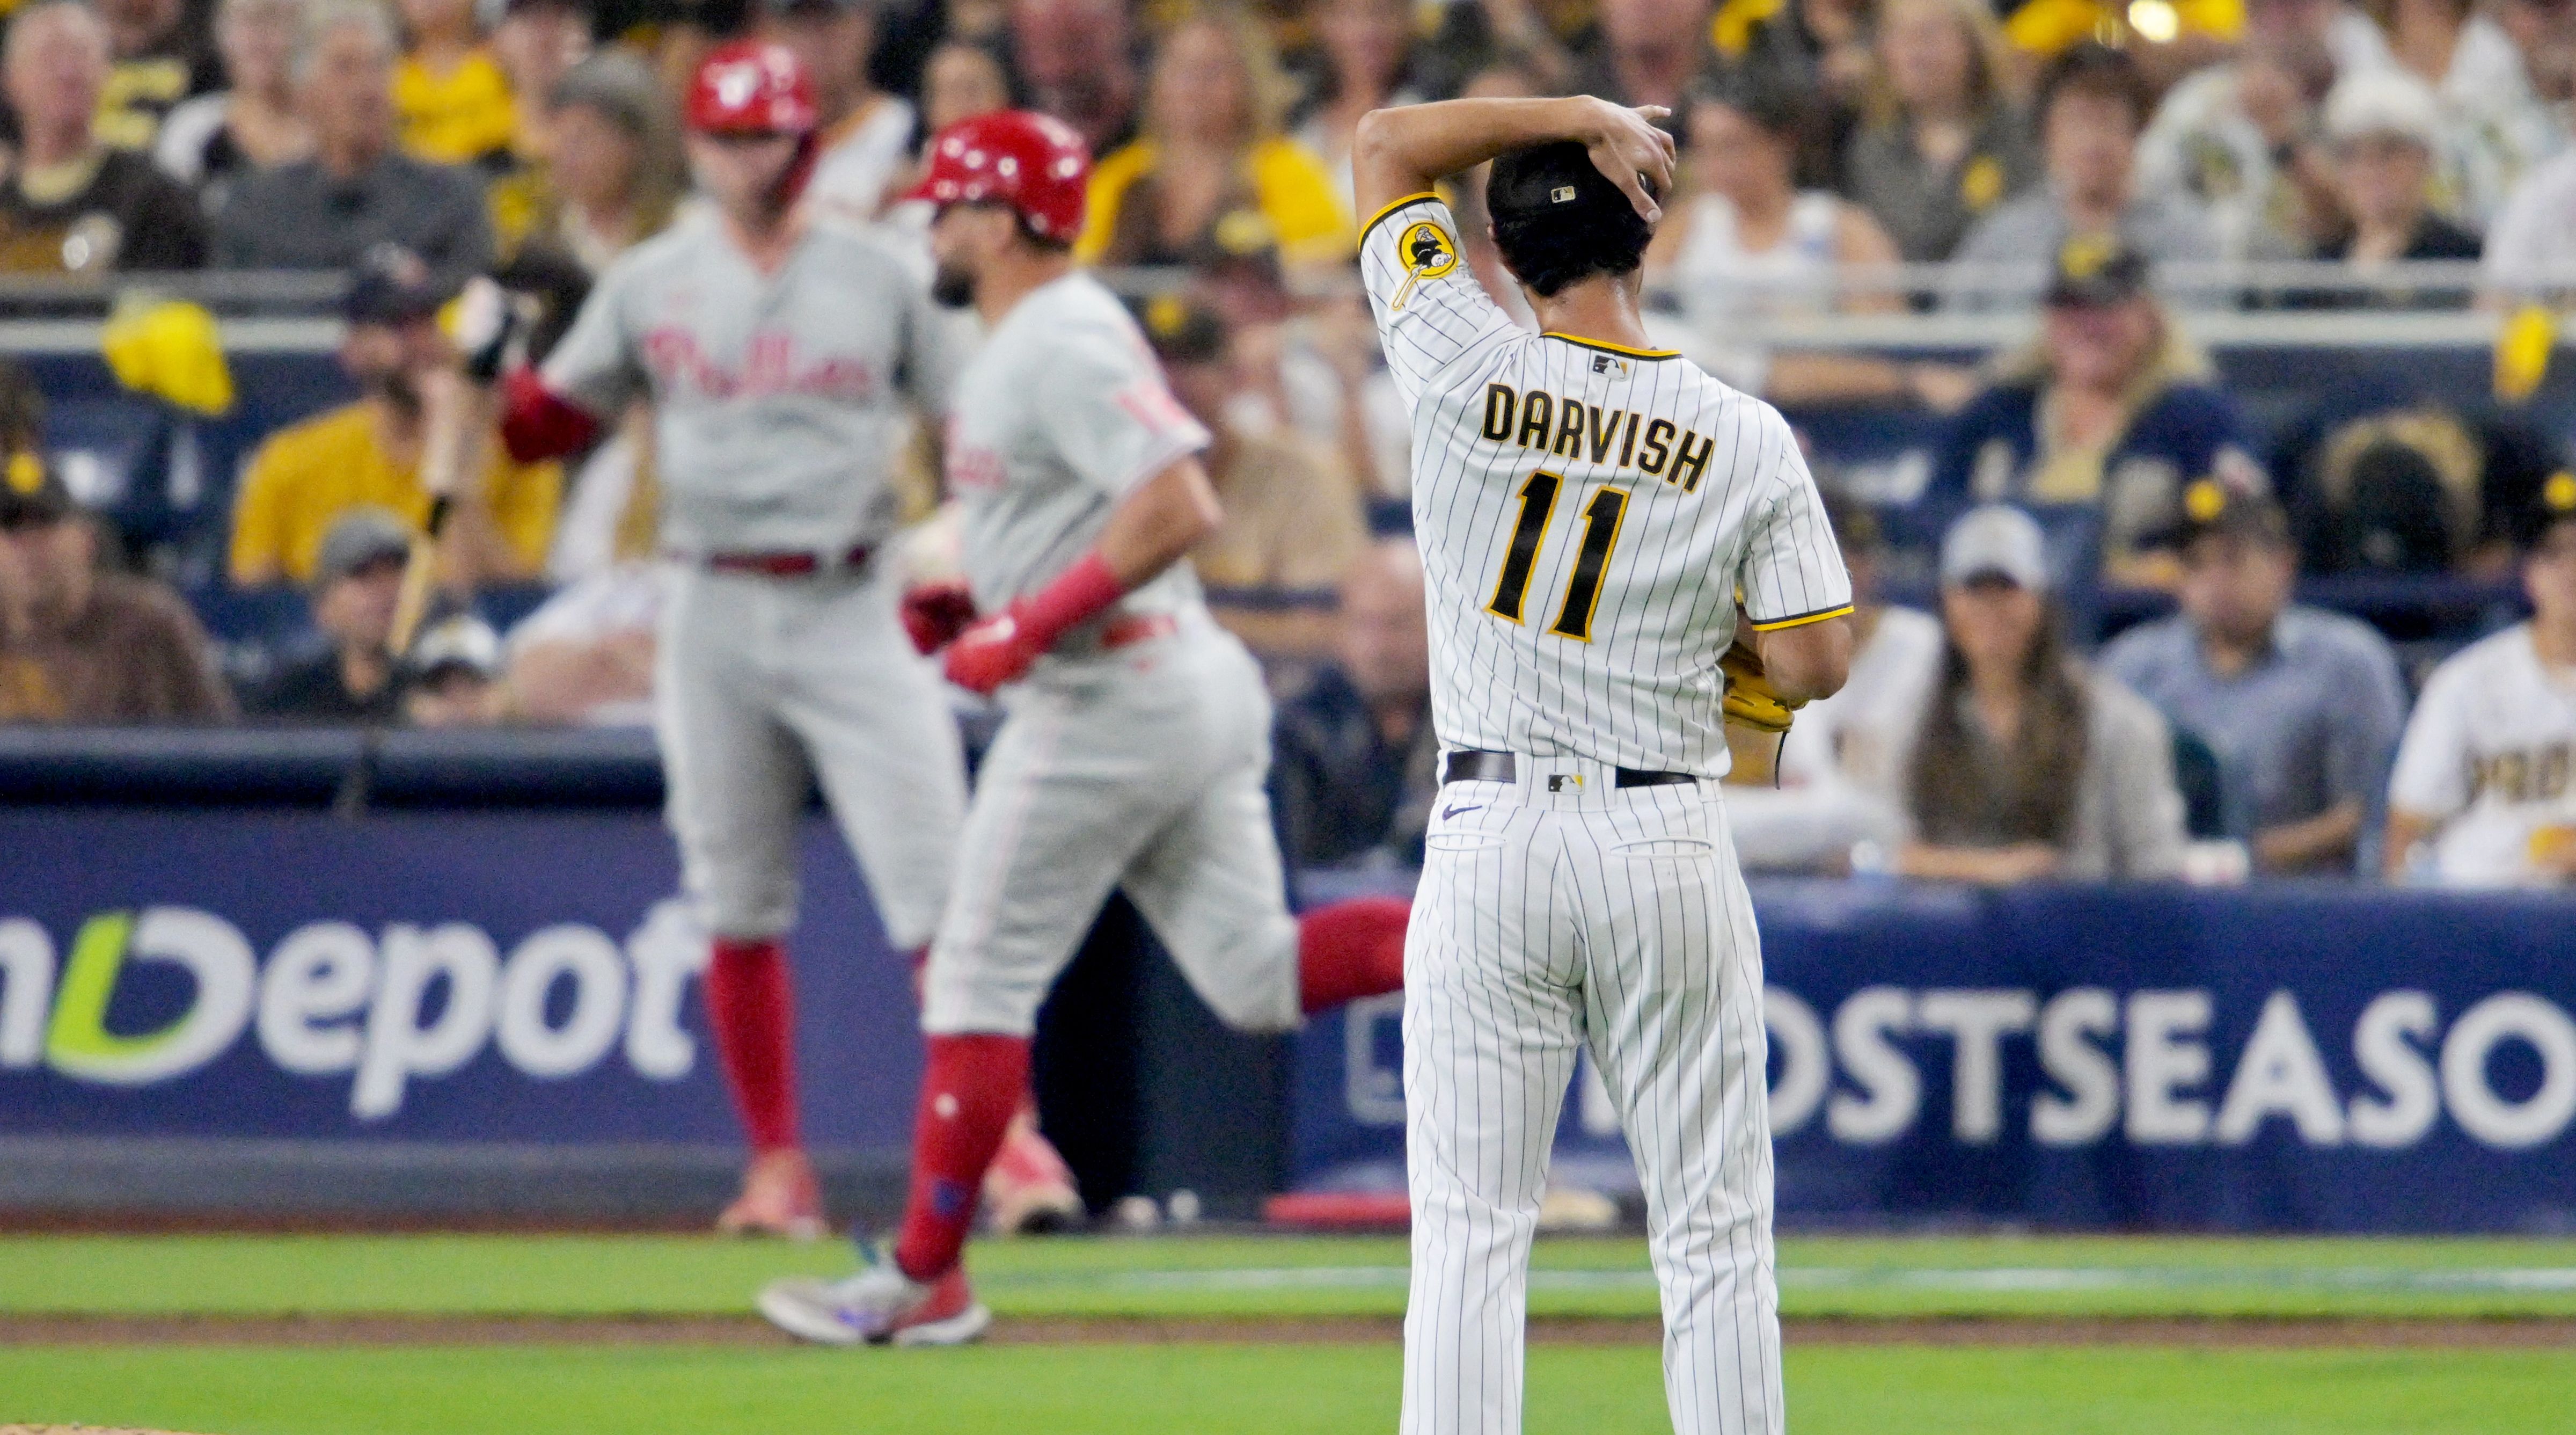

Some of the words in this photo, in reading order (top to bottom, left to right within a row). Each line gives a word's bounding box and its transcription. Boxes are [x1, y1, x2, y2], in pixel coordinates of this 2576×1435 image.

[1483, 382, 1716, 494] DARVISH
[1482, 468, 1630, 643] 11
[1578, 985, 2576, 1146] STSEASO
